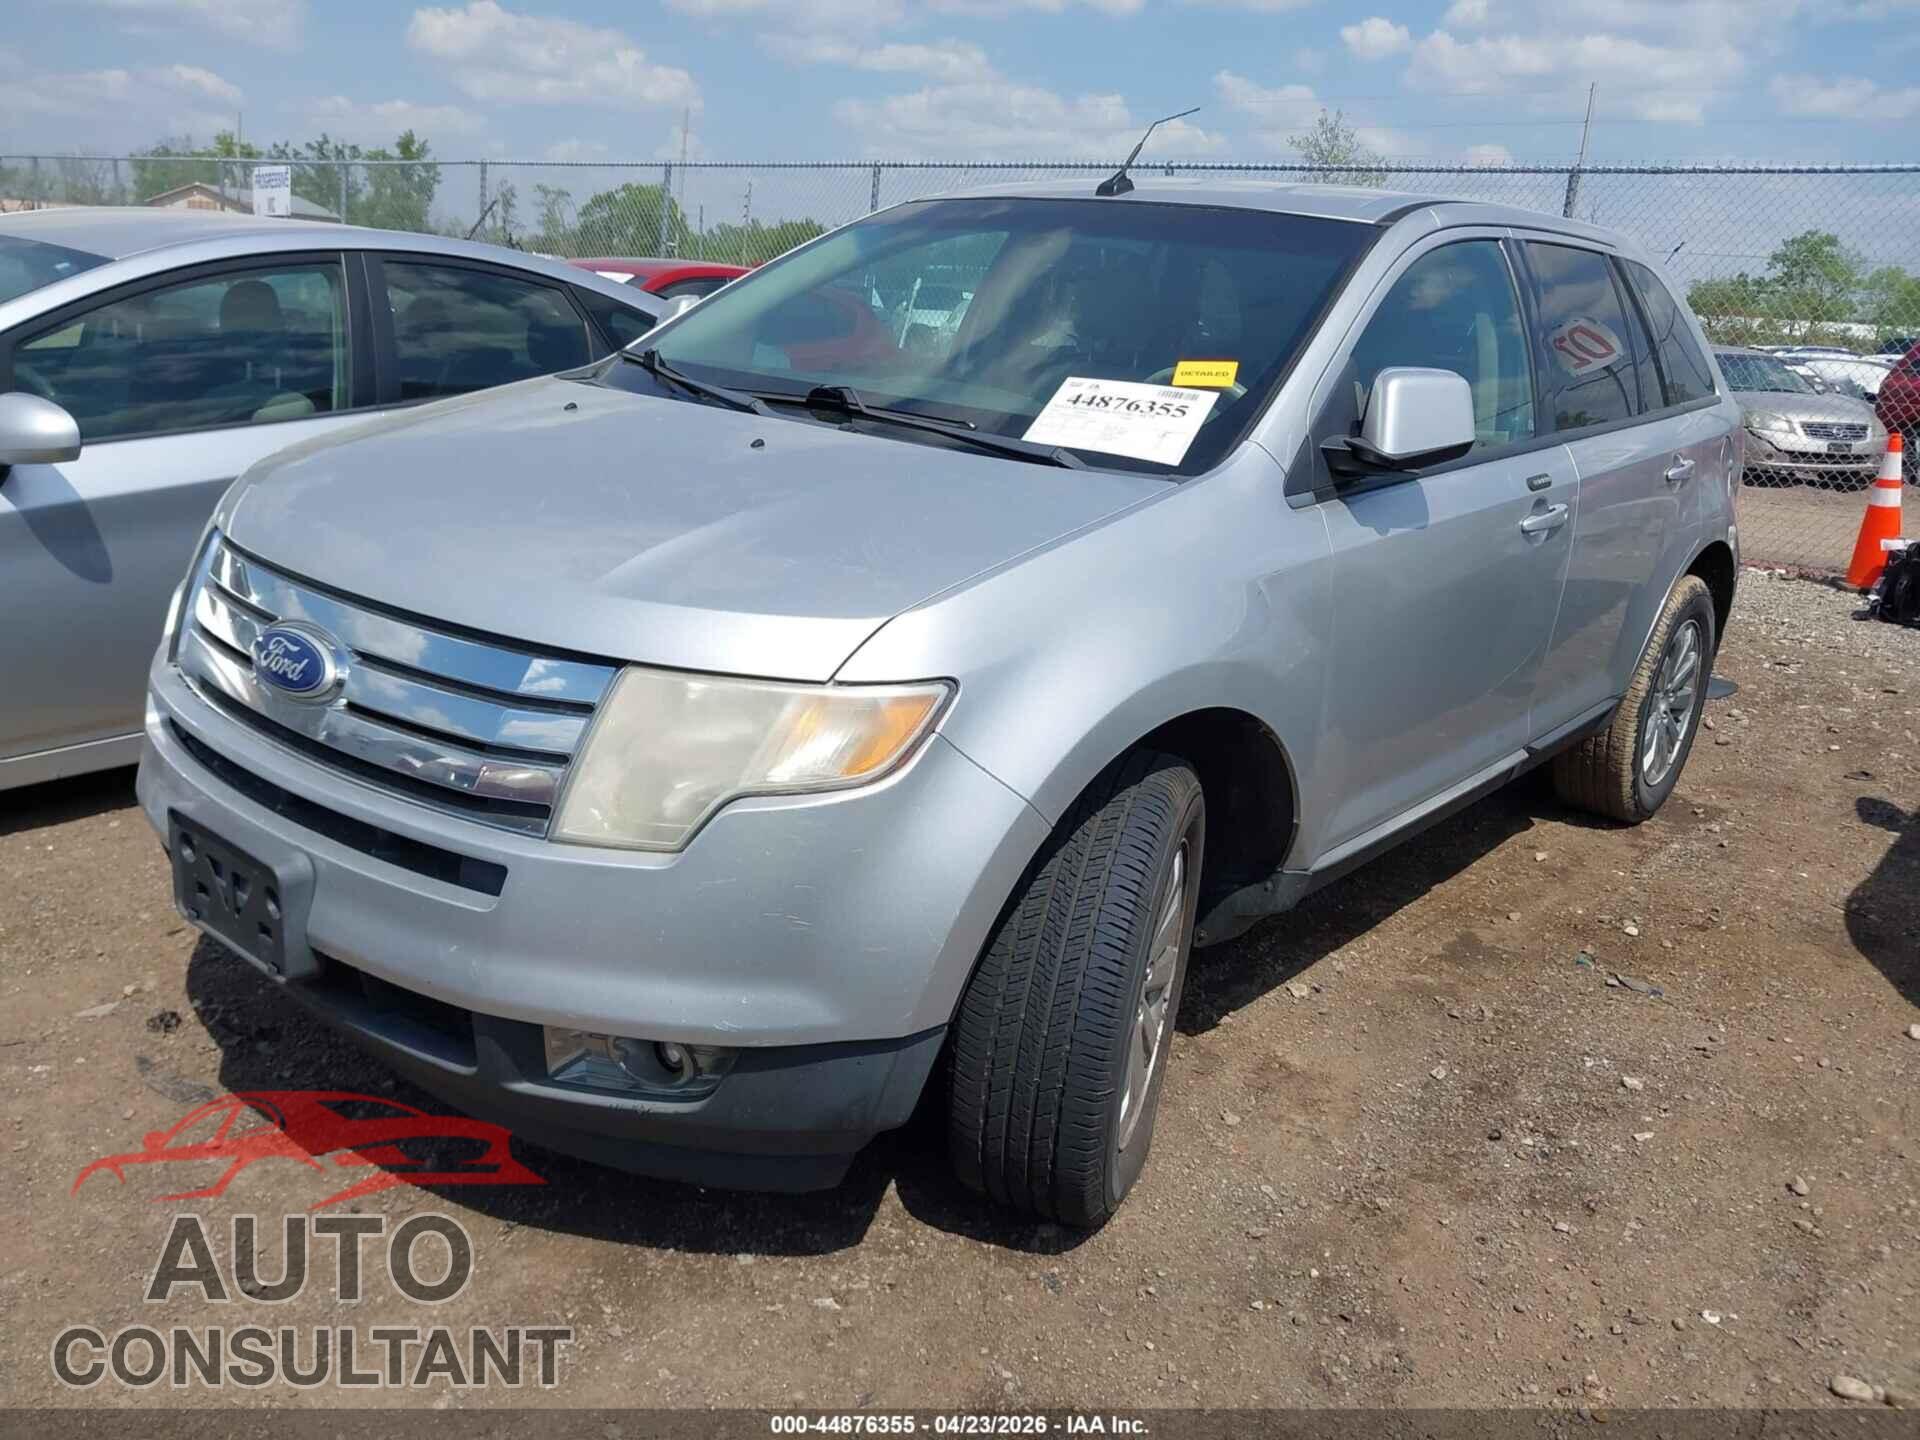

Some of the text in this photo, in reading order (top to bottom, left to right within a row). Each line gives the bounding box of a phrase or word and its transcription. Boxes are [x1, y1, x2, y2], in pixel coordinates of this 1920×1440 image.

[1180, 370, 1230, 378] DETAILED
[1066, 392, 1190, 418] 44876355
[260, 636, 309, 681] Ford
